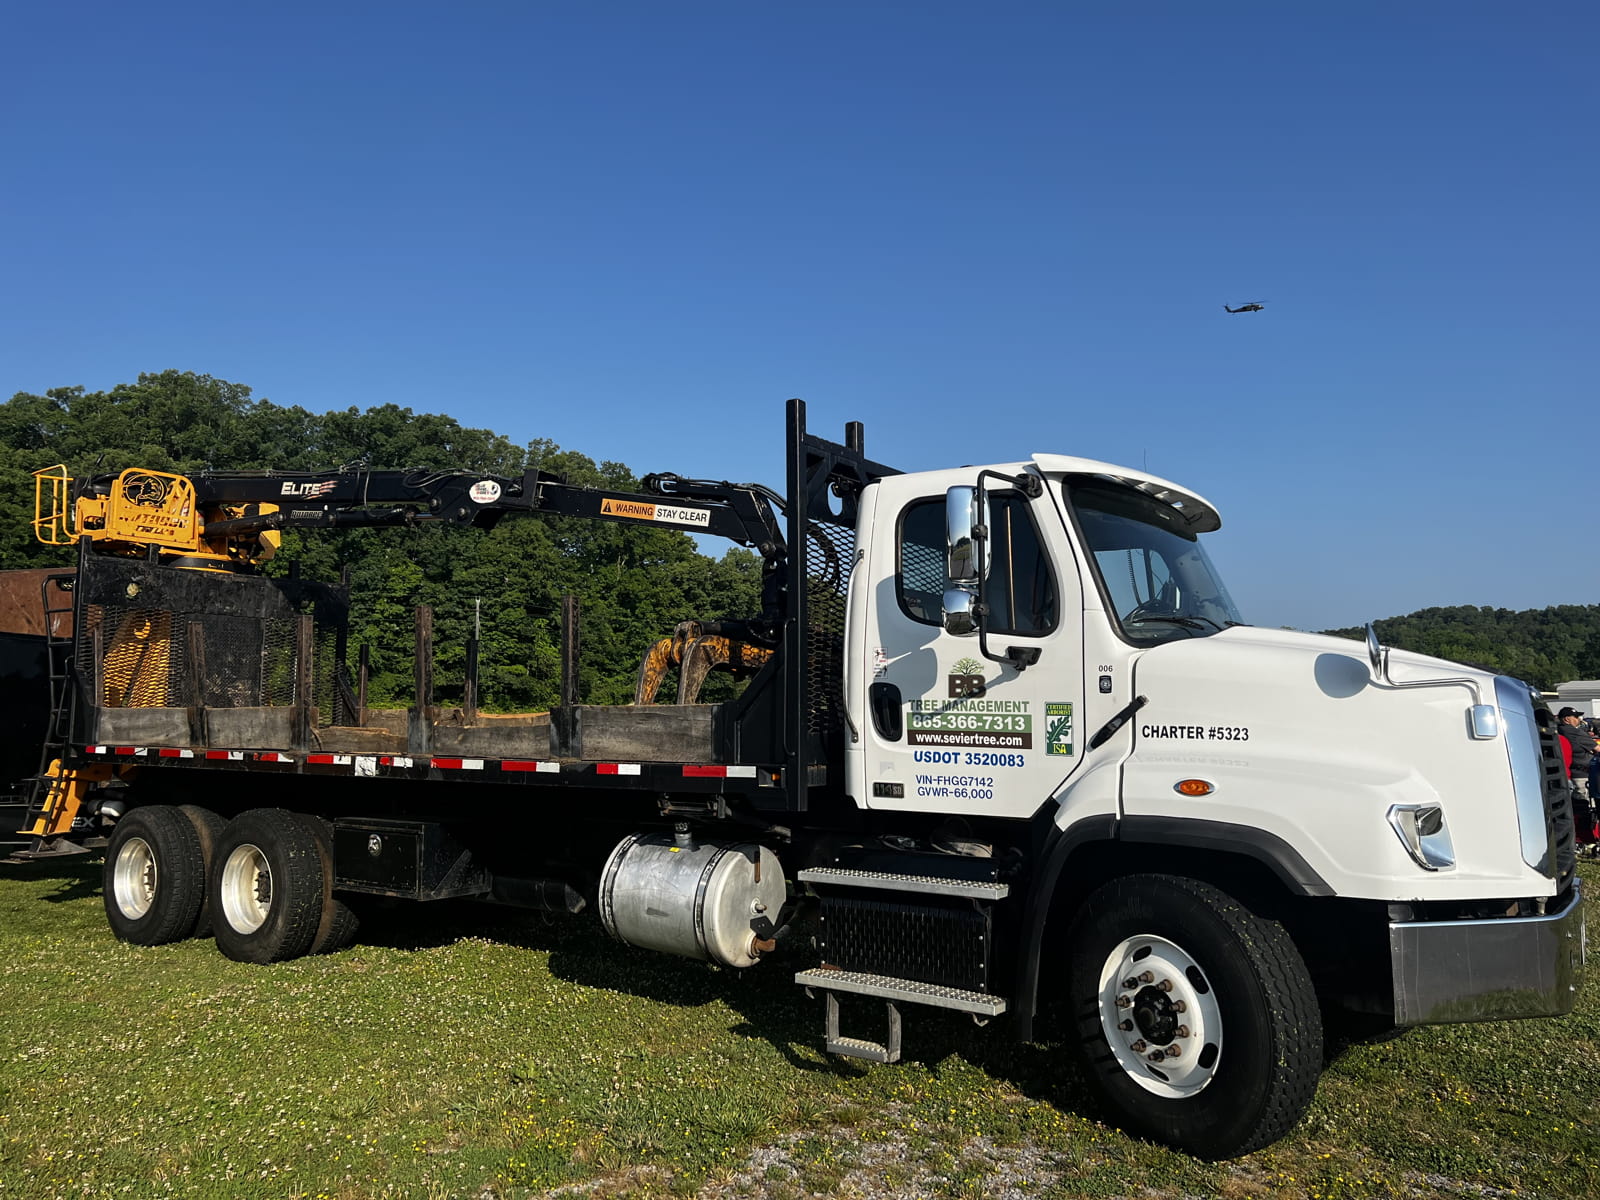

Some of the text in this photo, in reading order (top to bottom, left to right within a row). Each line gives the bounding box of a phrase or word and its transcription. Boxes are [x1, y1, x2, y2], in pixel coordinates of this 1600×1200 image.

[281, 481, 322, 495] ELITE
[616, 503, 707, 523] WARNING STAY CLEAR
[1098, 664, 1113, 673] 006
[909, 700, 1030, 713] TREE MANAGEMENT
[912, 714, 1025, 731] 865-366-7313
[916, 733, 1022, 746] www.seviertree.com
[1142, 725, 1249, 741] CHARTER #5323
[1053, 743, 1067, 754] ISA
[914, 750, 1025, 767] USDOT 3520083
[916, 774, 994, 788] VIN-FHGG7142
[917, 786, 993, 800] GVWR-66,000
